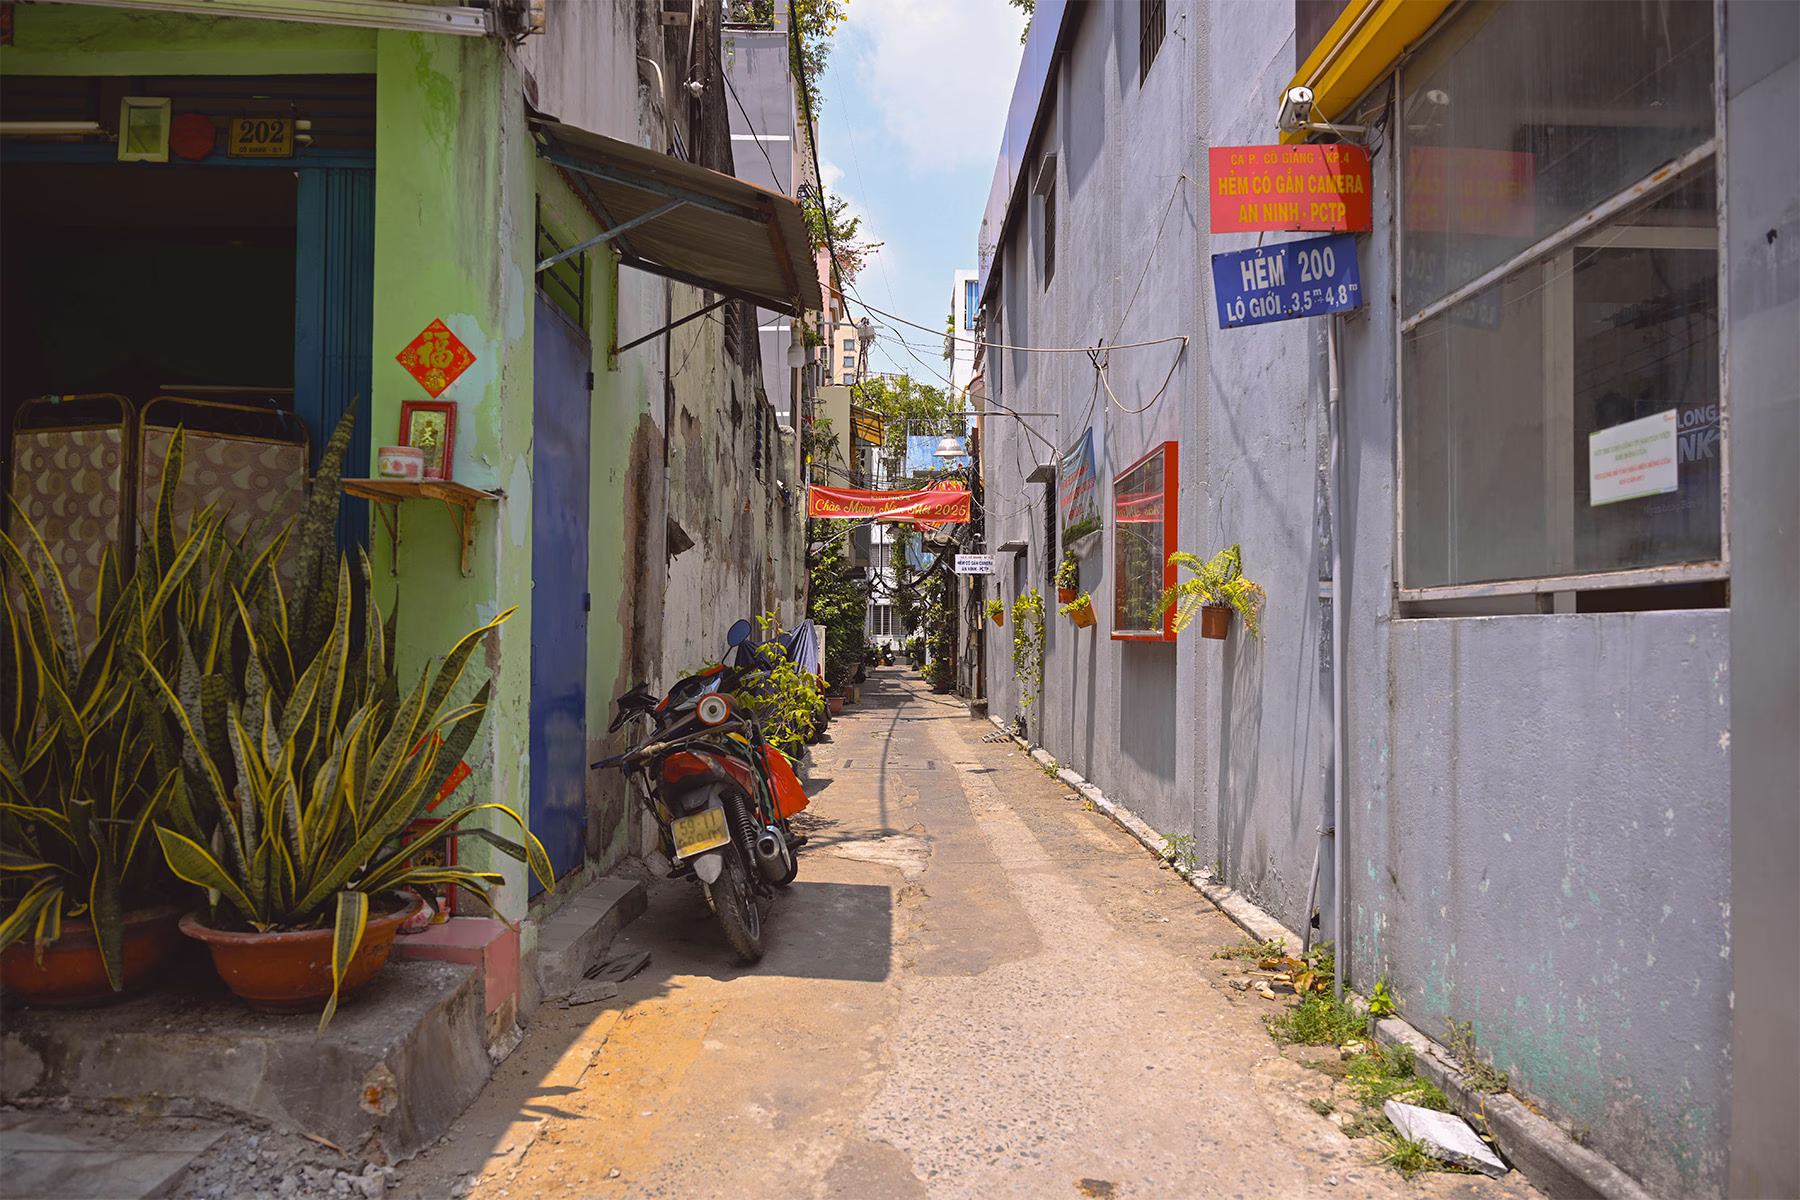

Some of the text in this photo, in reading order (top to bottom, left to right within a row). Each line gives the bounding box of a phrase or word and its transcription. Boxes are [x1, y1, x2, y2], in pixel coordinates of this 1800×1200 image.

[239, 120, 285, 143] 202
[1231, 153, 1245, 166] CA
[1249, 153, 1259, 165] P.
[1264, 150, 1278, 165] CÔ
[1282, 152, 1315, 165] GIANG
[1218, 167, 1364, 196] HẺM CÓ GẮN CAMERA
[1238, 203, 1259, 223] AN
[1263, 202, 1299, 223] NINH
[1310, 202, 1347, 223] PCTP
[1240, 246, 1335, 292] HẺM 200
[1226, 296, 1246, 323] LỘ
[416, 331, 455, 369] 福
[1678, 430, 1716, 465] NK
[814, 498, 841, 512] Chào
[843, 500, 877, 516] Mừng
[934, 503, 968, 517] 2025
